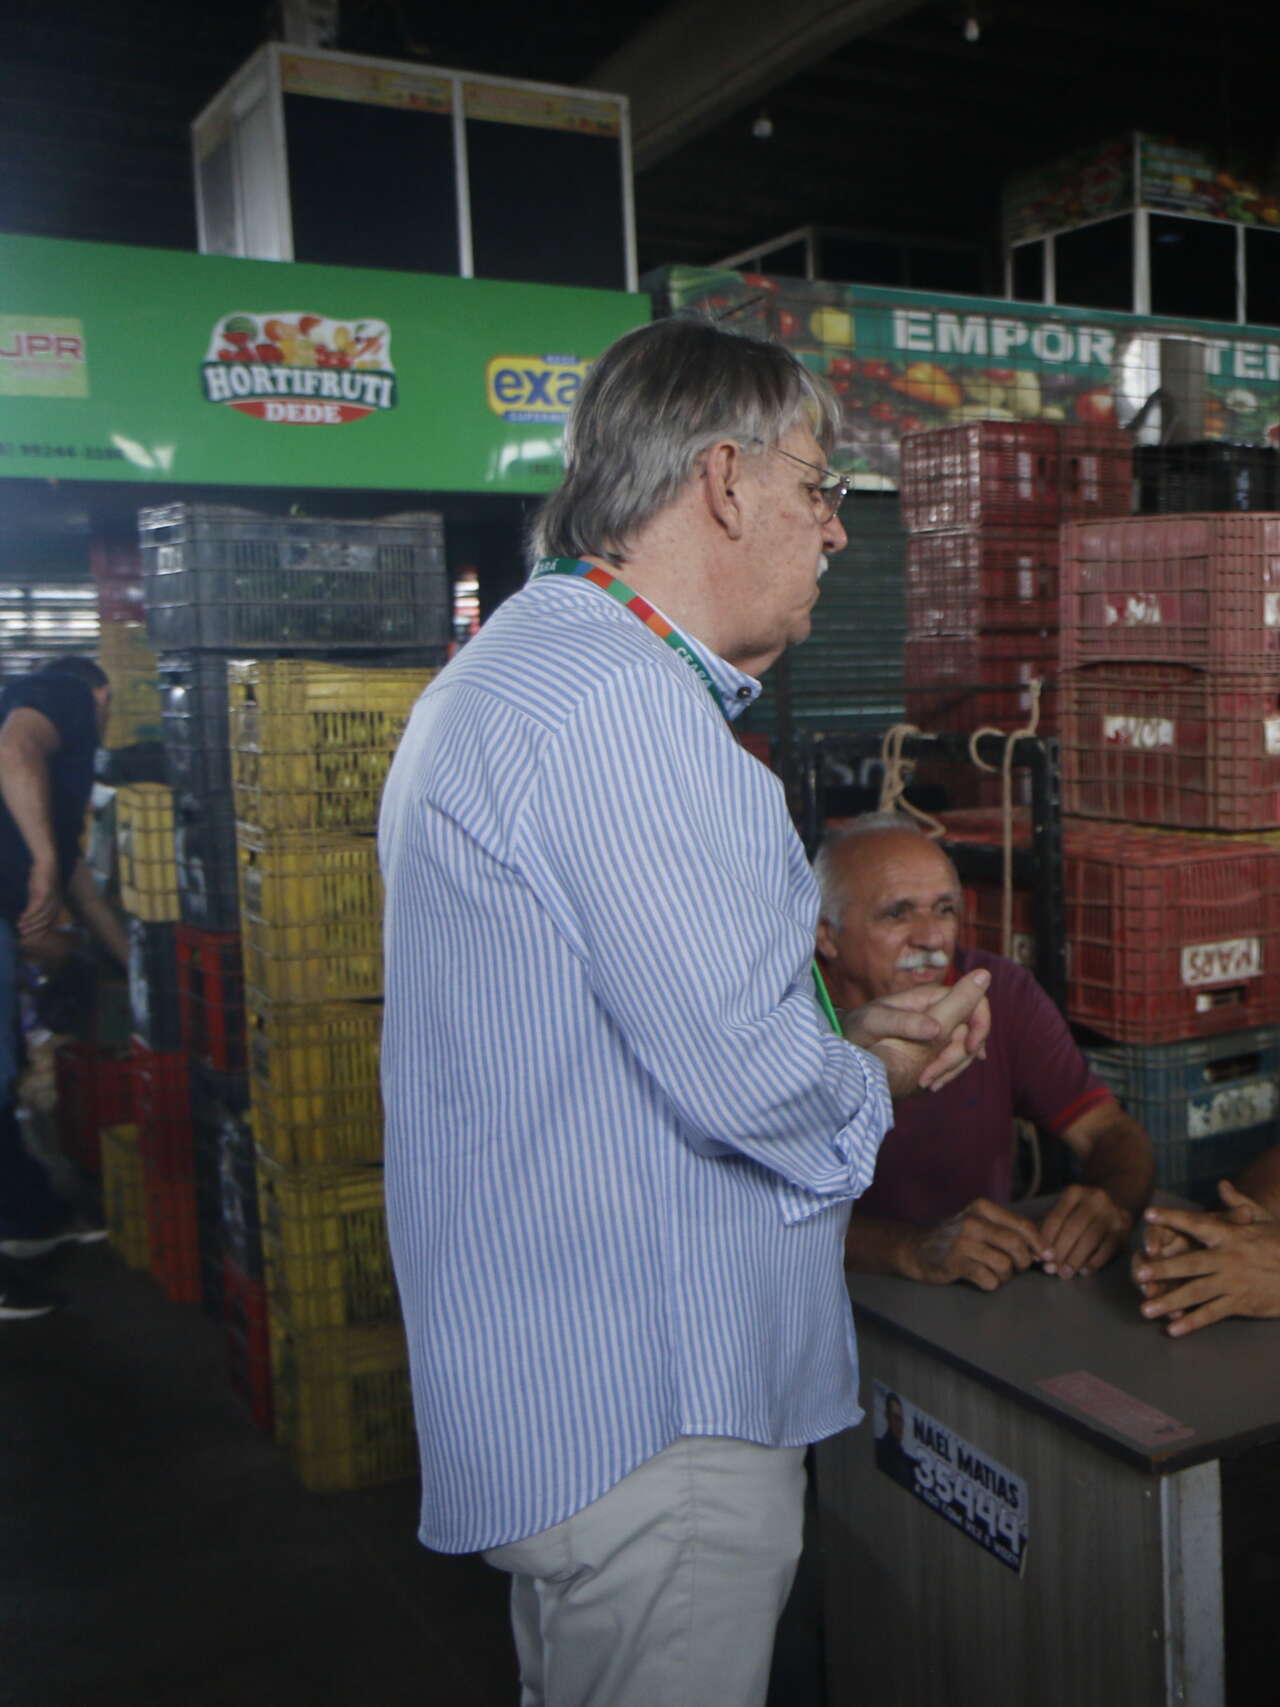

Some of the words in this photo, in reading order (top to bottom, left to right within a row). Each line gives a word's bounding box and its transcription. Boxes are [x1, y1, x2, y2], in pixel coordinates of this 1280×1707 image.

[204, 365, 393, 409] HORTIFRUTI
[494, 367, 590, 406] exa
[264, 401, 343, 425] DEDE
[913, 1413, 952, 1464] NAEL
[958, 1447, 1019, 1509] MATIAS
